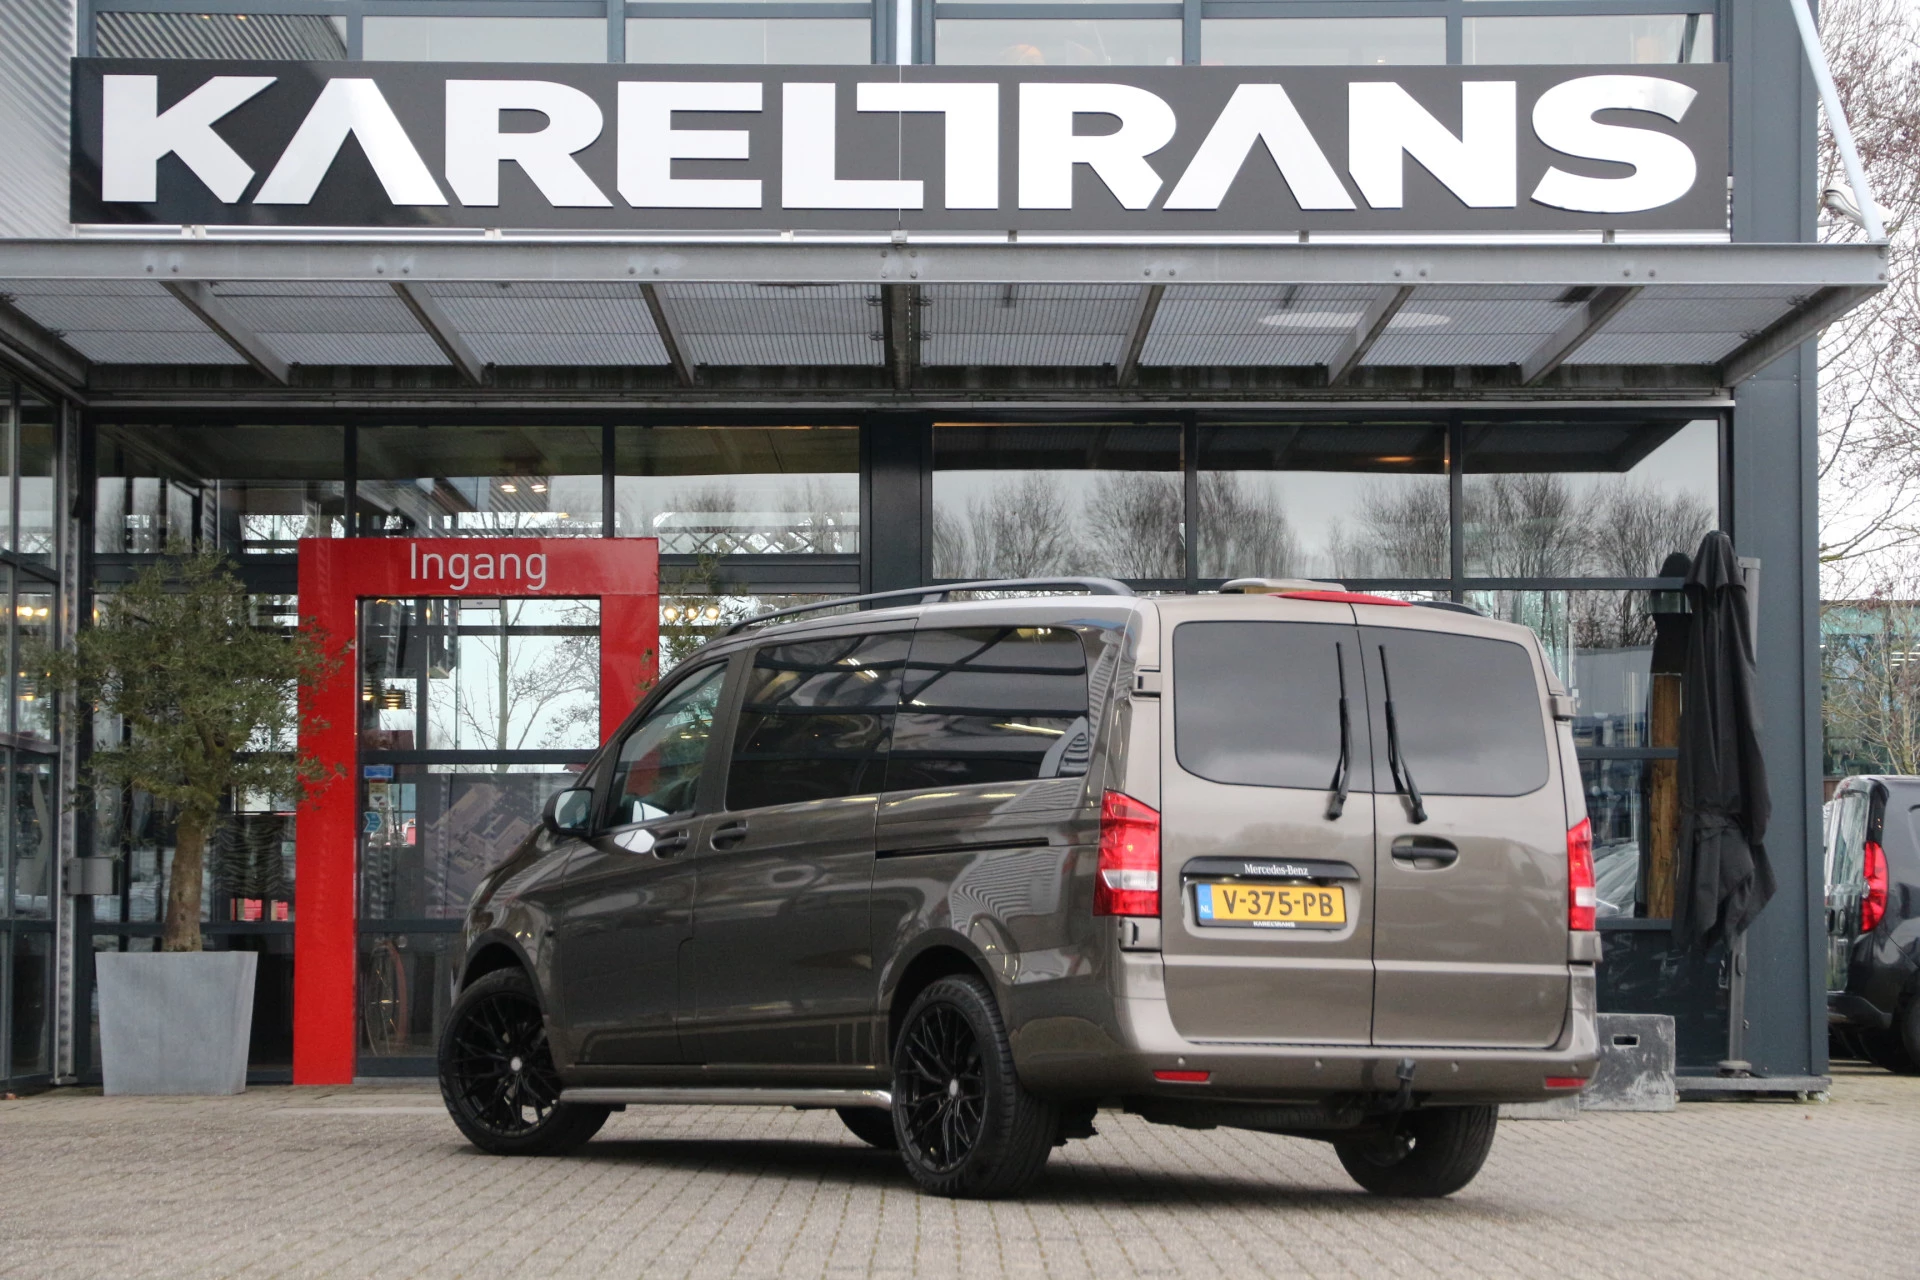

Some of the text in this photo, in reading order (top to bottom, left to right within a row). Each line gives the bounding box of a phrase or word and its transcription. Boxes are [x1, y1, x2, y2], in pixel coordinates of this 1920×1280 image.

[102, 73, 1698, 213] KARELTRANS
[410, 542, 547, 591] Ingang
[1244, 864, 1309, 876] Mercedes-Benz
[1200, 904, 1212, 914] NL
[1222, 889, 1334, 917] V-375-PB
